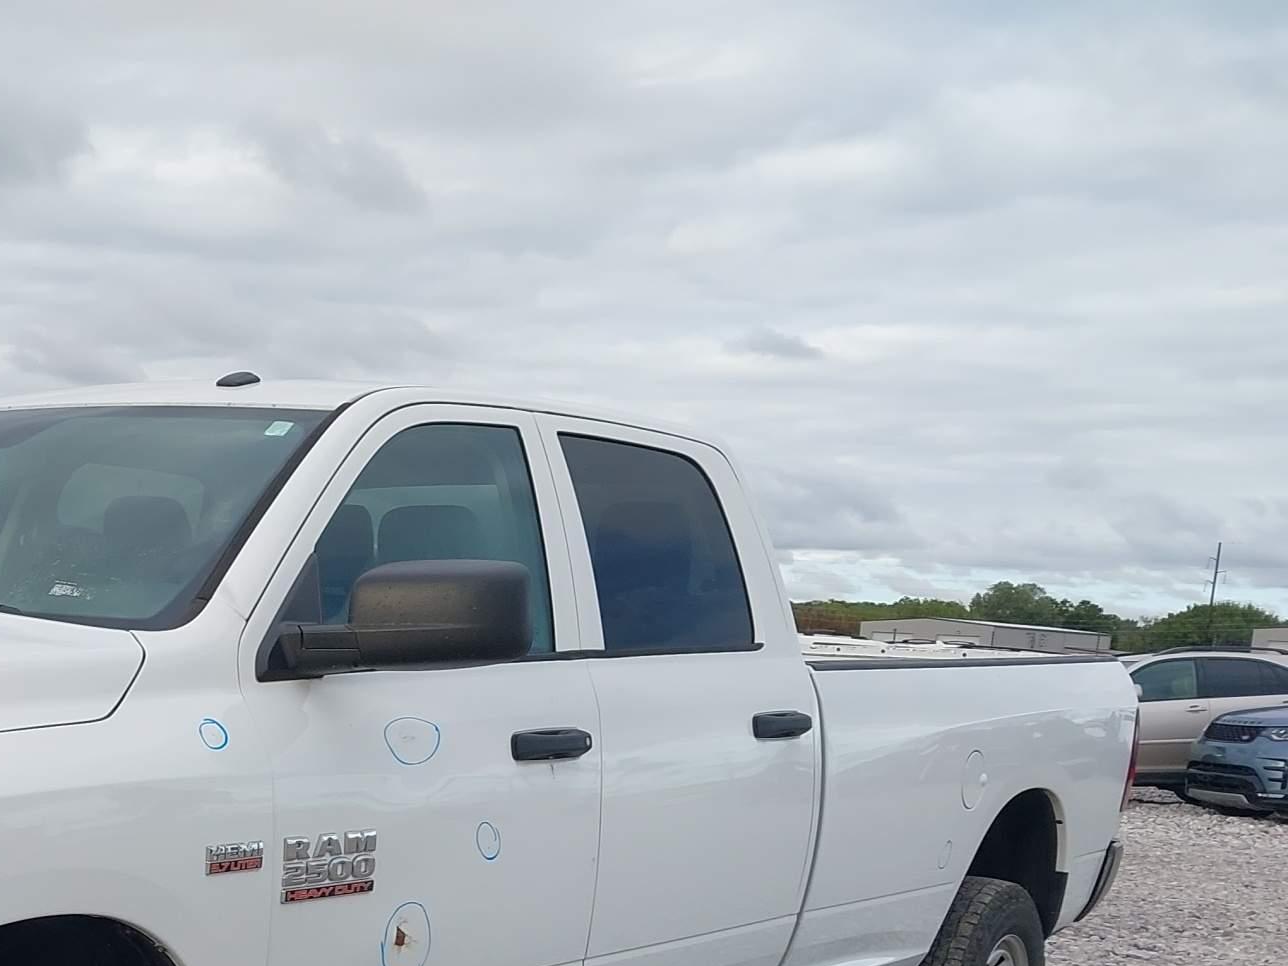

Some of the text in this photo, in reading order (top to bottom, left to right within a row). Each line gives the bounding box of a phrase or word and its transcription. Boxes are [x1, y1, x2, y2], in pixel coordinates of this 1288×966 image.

[206, 841, 264, 862] HEMI
[283, 829, 377, 861] RAM
[229, 859, 262, 870] LITER
[282, 854, 376, 887] 2500
[287, 882, 372, 901] HEAVY DUTY
